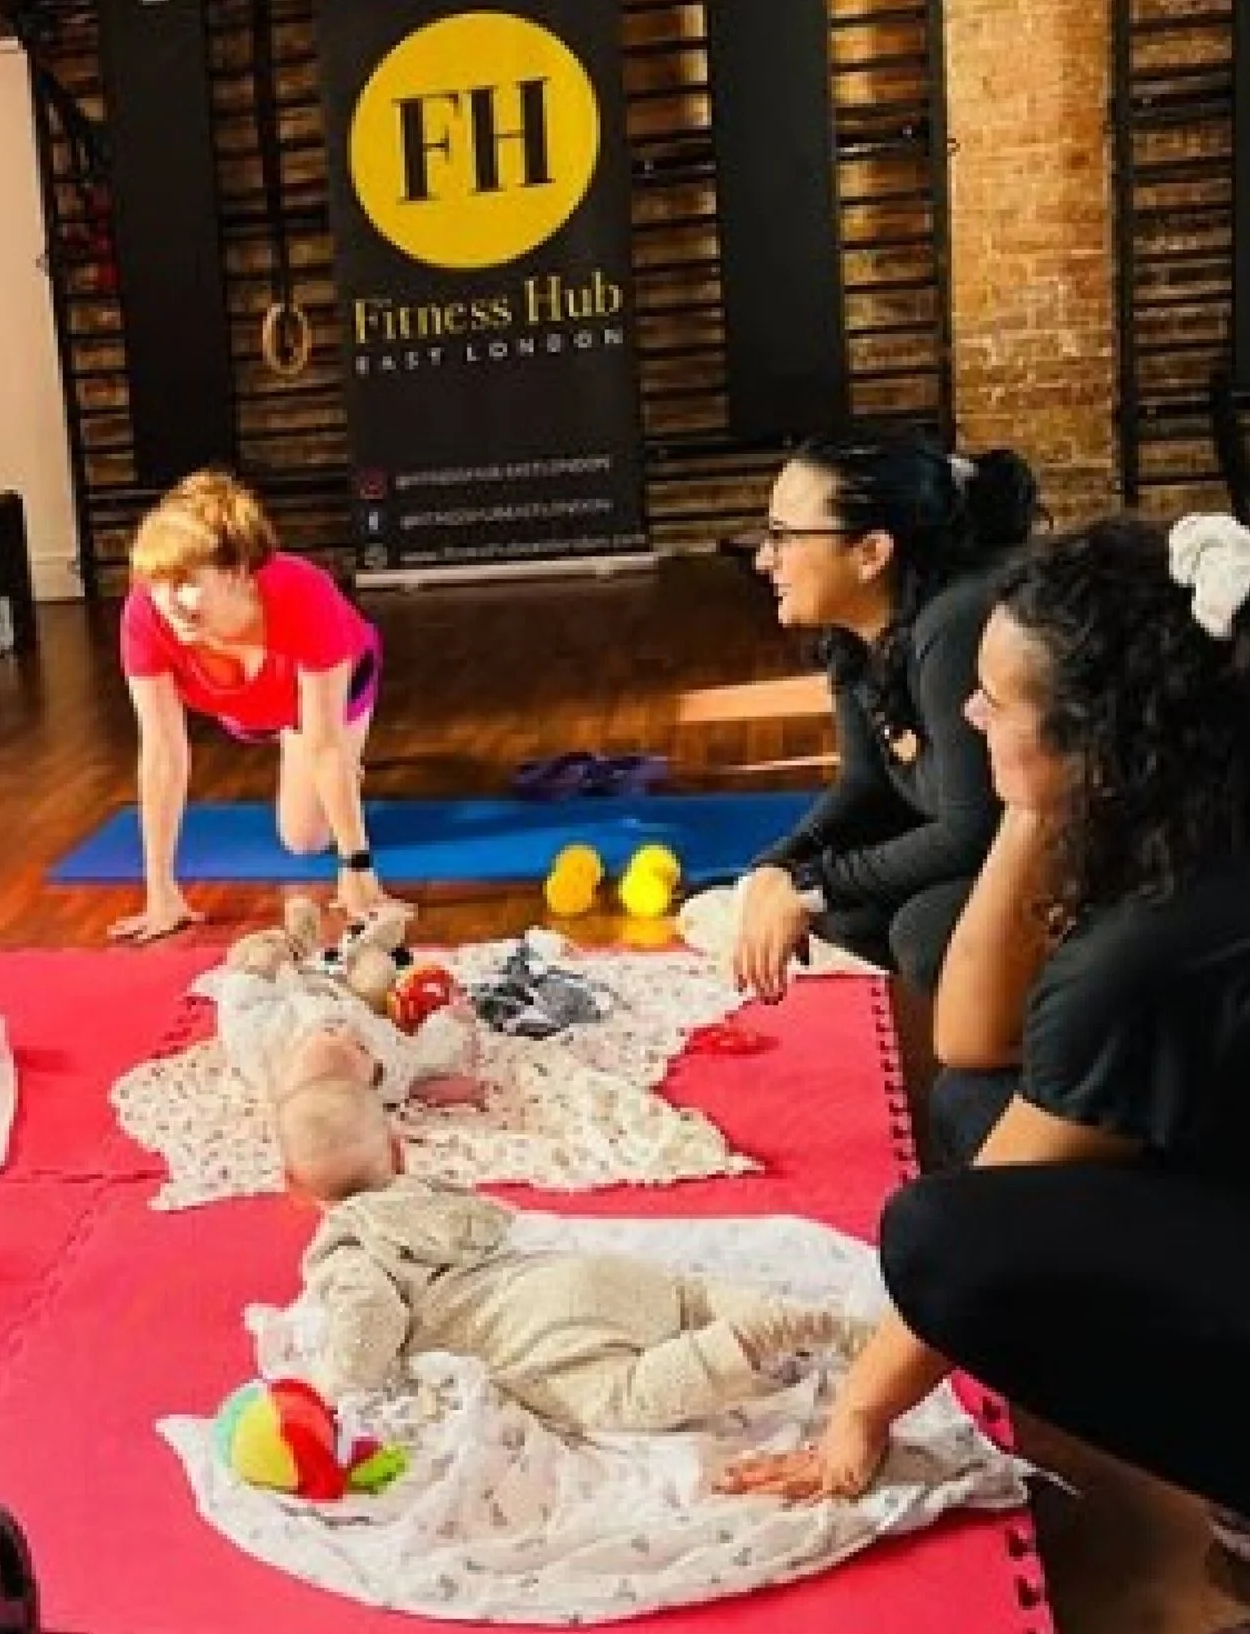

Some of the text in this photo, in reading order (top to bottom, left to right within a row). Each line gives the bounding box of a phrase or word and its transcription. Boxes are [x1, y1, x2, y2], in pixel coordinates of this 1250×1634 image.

[392, 76, 555, 205] FH
[355, 271, 623, 344] Fitness Hub
[355, 328, 624, 376] EAST LONDON
